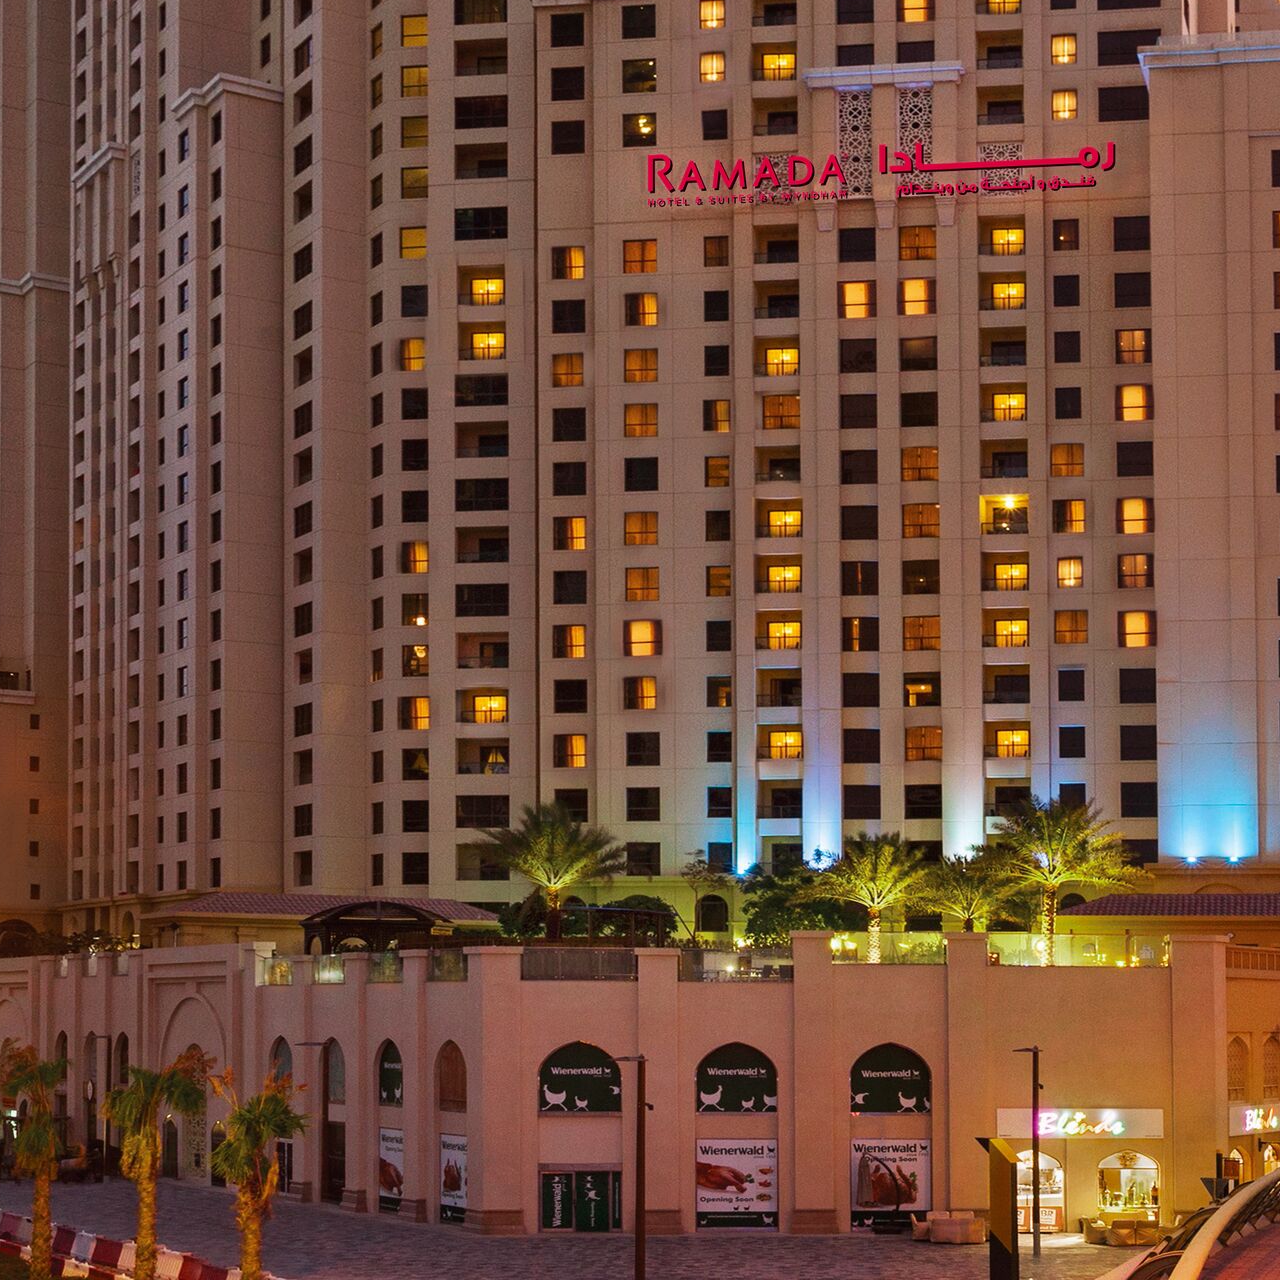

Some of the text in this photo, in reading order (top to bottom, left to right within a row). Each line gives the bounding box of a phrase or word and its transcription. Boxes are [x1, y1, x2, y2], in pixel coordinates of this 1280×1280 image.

[878, 141, 1116, 174] رمادا
[647, 154, 848, 193] RAMADA
[647, 196, 690, 208] HOTEL
[709, 192, 755, 205] SUITES
[782, 189, 849, 202] WYNDHAM
[551, 1067, 602, 1075] Wienerwald
[707, 1067, 758, 1076] Wienerwald
[861, 1069, 911, 1078] Wienerwald
[1038, 1111, 1125, 1135] Blends
[700, 1145, 764, 1156] Wienerwald
[853, 1143, 917, 1153] Wienerwald
[700, 1196, 733, 1204] Opening
